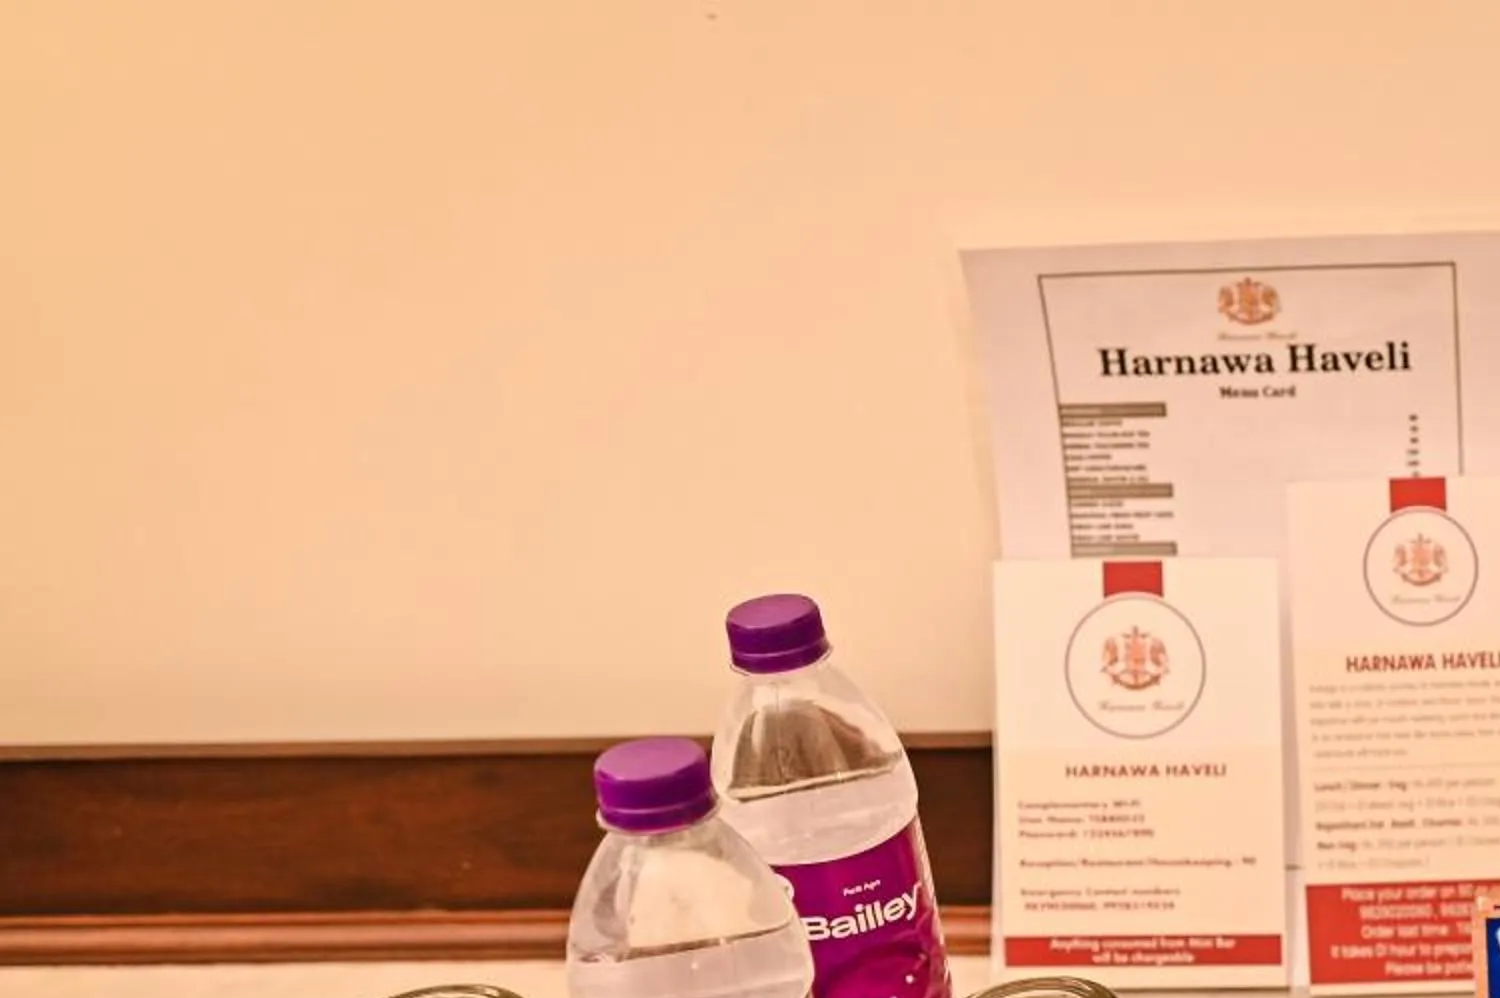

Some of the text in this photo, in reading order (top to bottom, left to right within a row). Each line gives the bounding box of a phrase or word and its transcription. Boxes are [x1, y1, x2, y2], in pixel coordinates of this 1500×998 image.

[1097, 341, 1412, 377] Harnawa Haveli
[1262, 385, 1296, 399] Card
[1346, 653, 1436, 673] HARNAWA
[1065, 763, 1227, 778] HARNAWA HAVELI
[802, 880, 923, 942] Bailley
